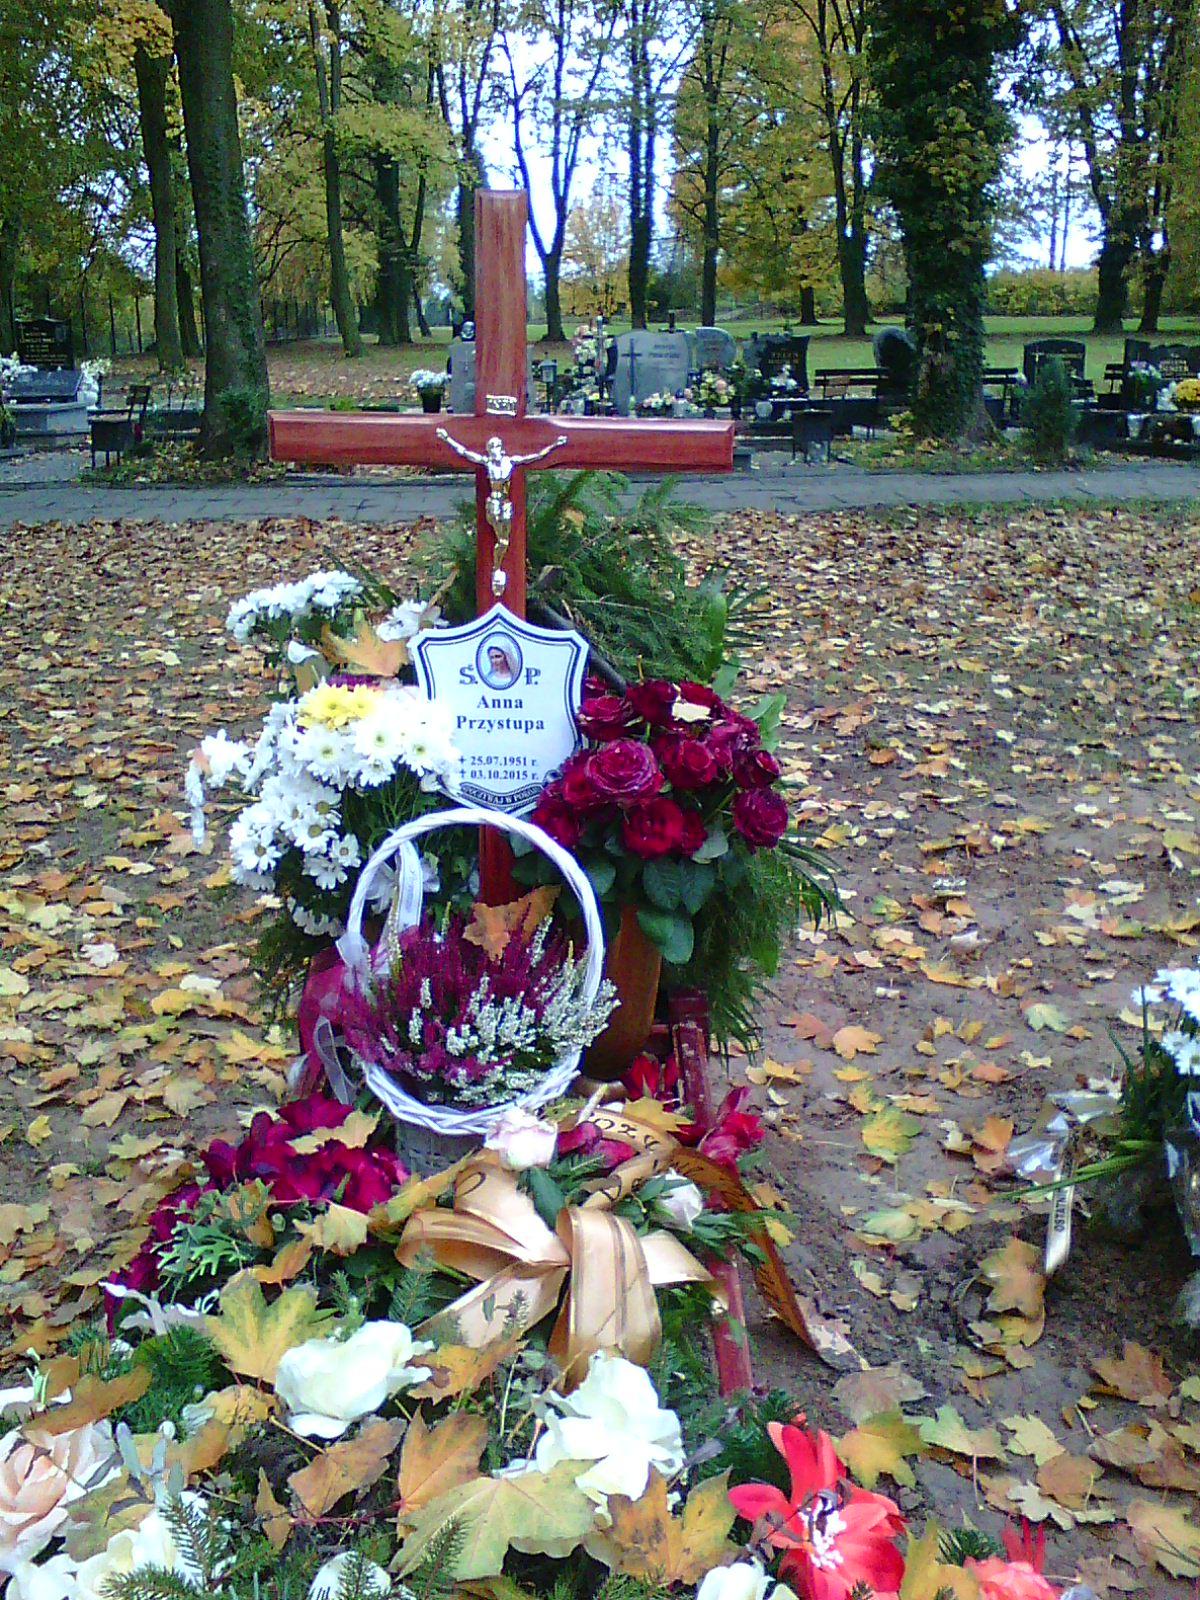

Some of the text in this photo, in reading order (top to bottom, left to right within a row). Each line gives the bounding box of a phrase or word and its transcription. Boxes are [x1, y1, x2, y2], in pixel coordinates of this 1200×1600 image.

[524, 667, 541, 685] P.
[476, 695, 523, 709] Anna
[456, 715, 545, 734] Przystupa
[470, 755, 527, 766] 25.07.1951
[470, 769, 528, 780] 03.10.2015
